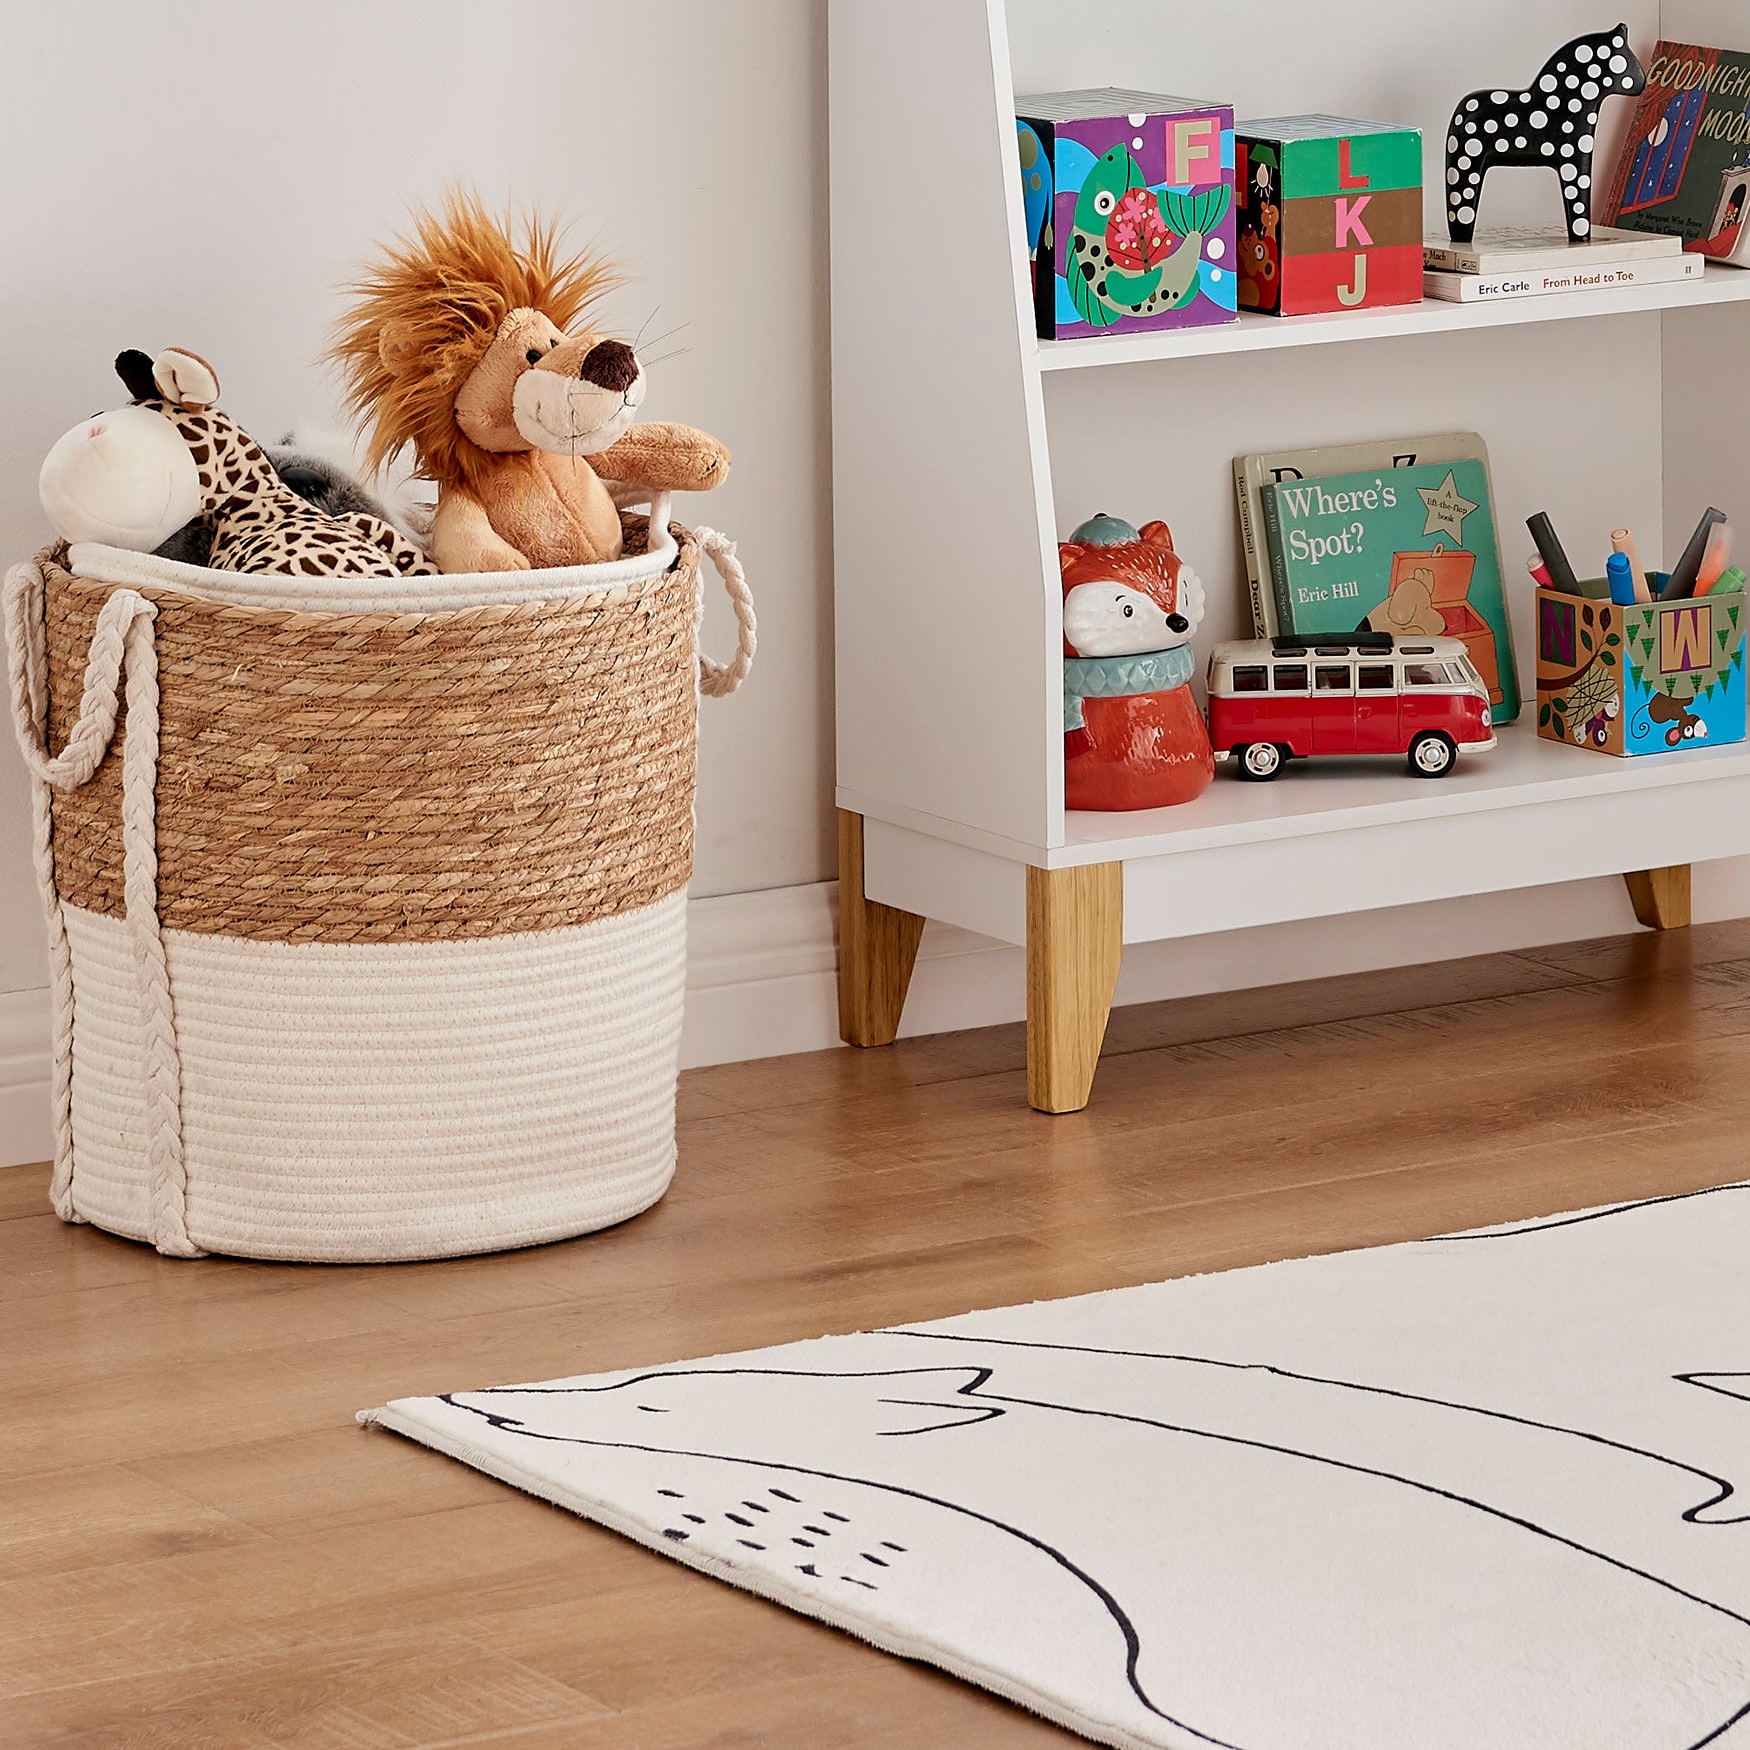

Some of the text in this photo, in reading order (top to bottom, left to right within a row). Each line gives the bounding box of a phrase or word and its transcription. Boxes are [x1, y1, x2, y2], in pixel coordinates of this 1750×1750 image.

[1174, 120, 1213, 184] F
[1338, 140, 1369, 190] L
[1335, 195, 1374, 249] K
[1336, 254, 1368, 307] J
[1478, 281, 1530, 295] Eric Carle
[1543, 271, 1634, 289] From Head to Toe
[1238, 476, 1254, 554] Rod Campbell
[1282, 478, 1397, 519] Where's
[1427, 497, 1468, 515] lift-the-flap
[1445, 490, 1452, 499] A
[1437, 511, 1455, 523] book
[1289, 522, 1364, 565] Spot?
[1251, 578, 1261, 620] Dear
[1297, 581, 1360, 604] Eric Hill
[1542, 600, 1574, 664] N
